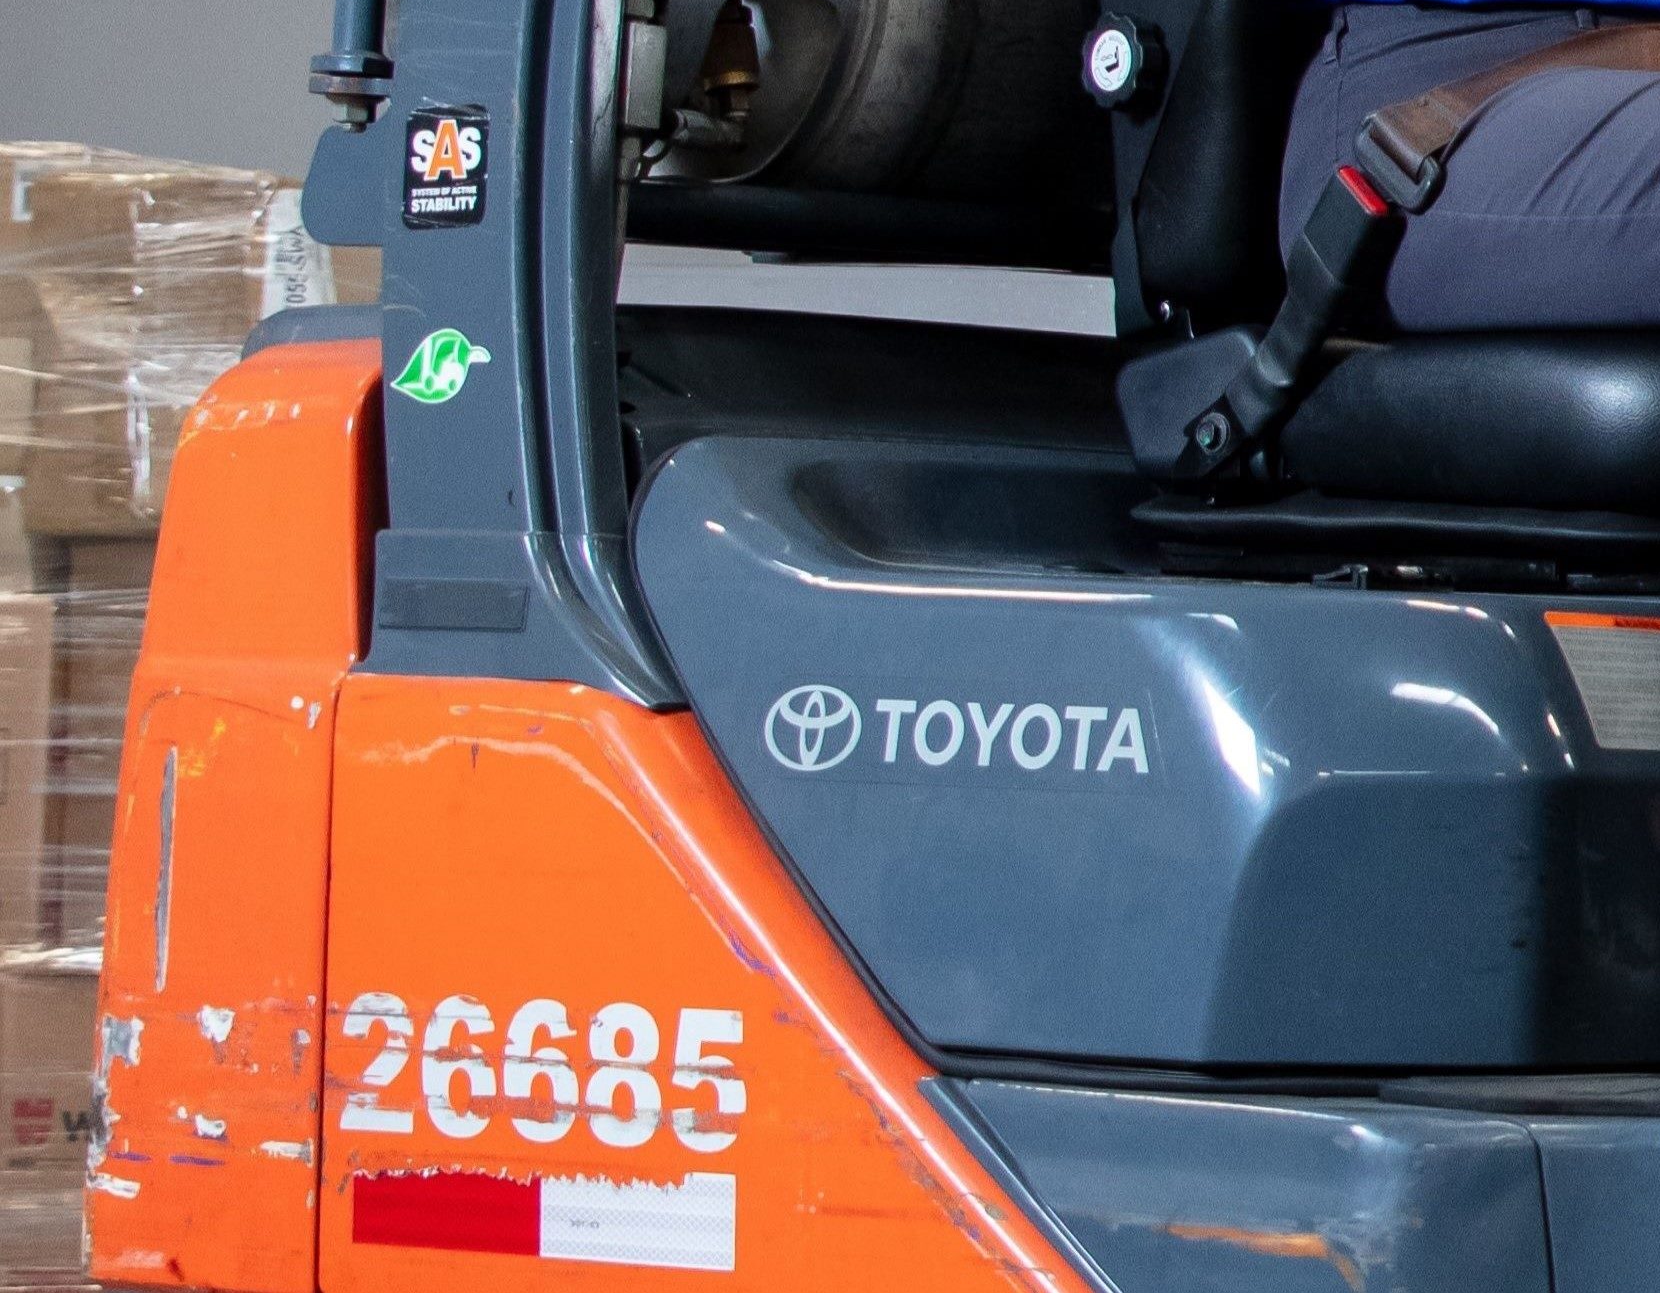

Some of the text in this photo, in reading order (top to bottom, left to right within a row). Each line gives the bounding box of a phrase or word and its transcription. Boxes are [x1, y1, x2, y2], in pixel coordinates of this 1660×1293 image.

[411, 118, 482, 181] SAS
[411, 185, 478, 197] SYSTEM OF ACTIVE
[411, 195, 478, 214] STABILITY
[876, 699, 1149, 773] TOYOTA
[340, 992, 747, 1153] 26685
